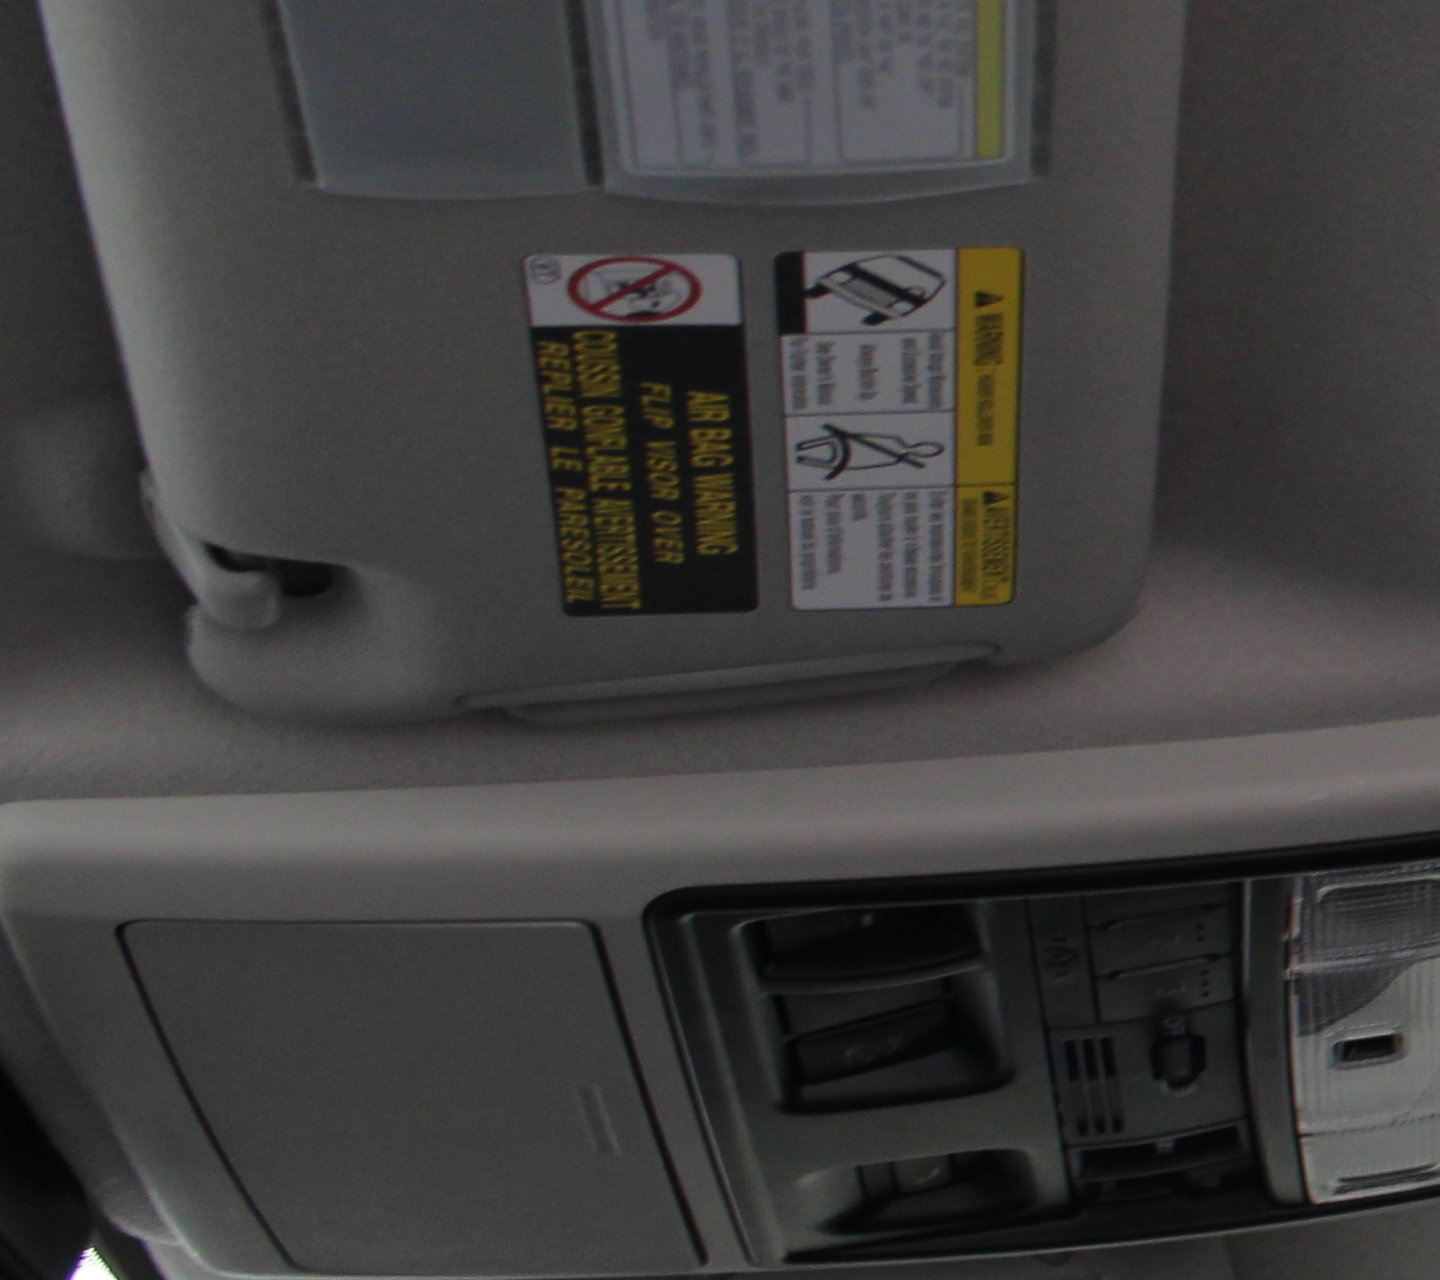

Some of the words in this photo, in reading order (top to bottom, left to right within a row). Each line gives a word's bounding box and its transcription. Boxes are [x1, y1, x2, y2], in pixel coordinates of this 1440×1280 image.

[536, 340, 577, 431] REPLIER
[570, 330, 624, 398] COUSSIN
[639, 381, 675, 429] FLIP
[685, 391, 730, 422] AIR
[549, 446, 583, 471] LE
[581, 405, 634, 492] GONFLABLE
[645, 440, 680, 501] VISOR
[691, 428, 735, 467] BAG
[650, 510, 685, 564] OVER
[693, 473, 739, 554] WARNING
[554, 487, 594, 605] PARESOLEIL
[592, 498, 641, 610] AVERTISSEMENT
